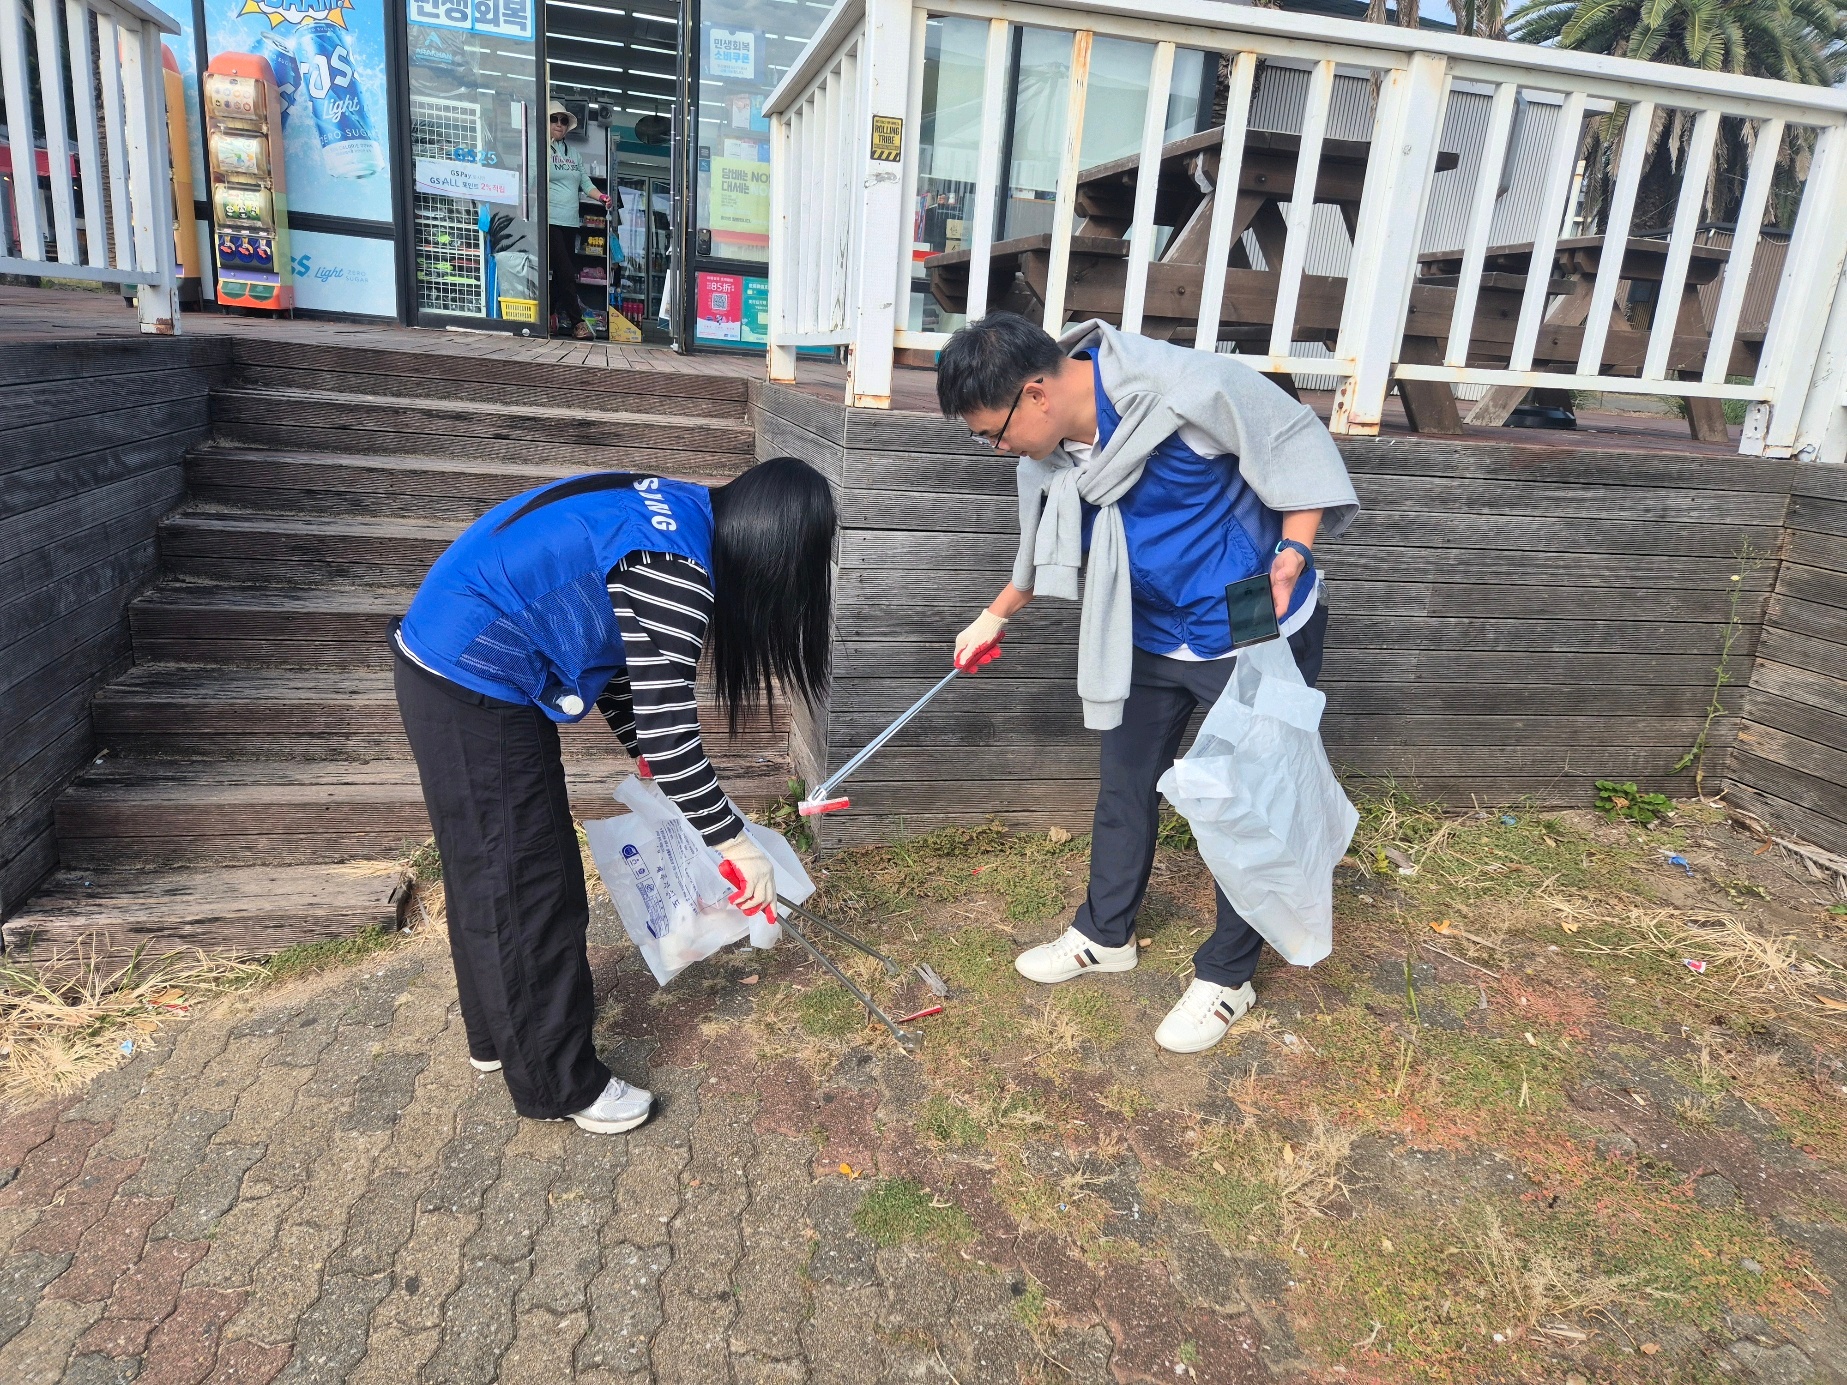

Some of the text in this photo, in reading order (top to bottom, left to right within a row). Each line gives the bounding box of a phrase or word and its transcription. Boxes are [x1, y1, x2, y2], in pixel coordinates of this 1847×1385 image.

[713, 38, 750, 53] 민생회복
[713, 50, 750, 64] 소비쿠폰
[323, 95, 360, 123] Light
[319, 130, 342, 145] ZERO
[875, 125, 900, 135] ROLLING
[878, 134, 896, 145] TRIBE
[454, 147, 498, 165] GS25
[450, 169, 460, 178] GS
[721, 167, 749, 182] 담배는
[429, 176, 441, 185] GS
[441, 177, 460, 188] ALL
[462, 181, 479, 190] 포인트
[721, 180, 750, 195] 대세는
[314, 266, 344, 283] Light
[347, 269, 367, 277] ZERO
